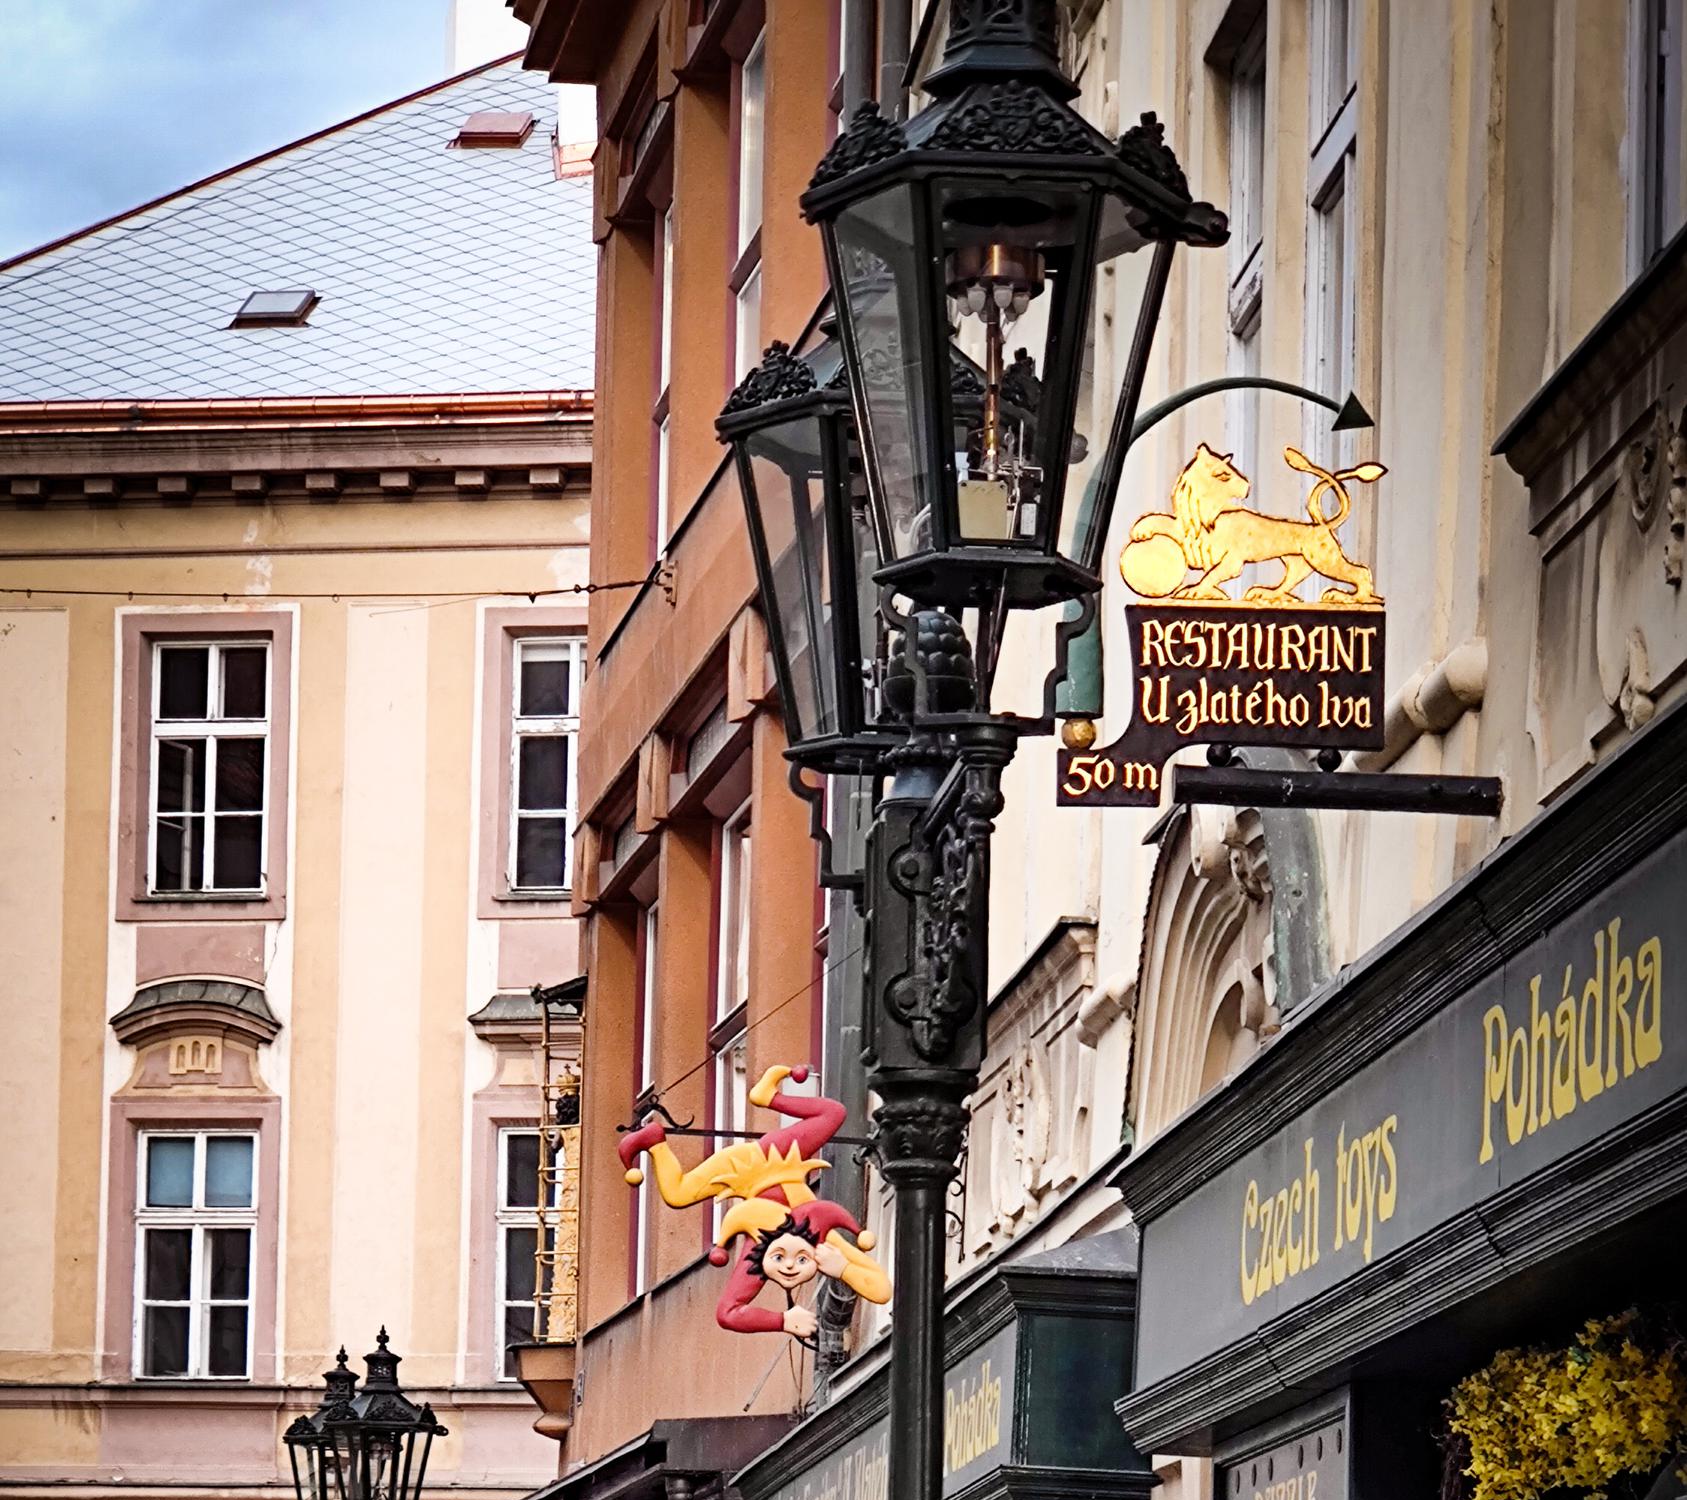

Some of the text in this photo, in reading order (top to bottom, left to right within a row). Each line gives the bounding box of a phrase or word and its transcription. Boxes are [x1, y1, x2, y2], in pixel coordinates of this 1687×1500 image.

[1139, 619, 1377, 673] RESTAURANT
[1140, 674, 1374, 735] U zlatého lva
[1062, 754, 1160, 796] 50 m
[1241, 916, 1663, 1306] Czech toys Pohádka
[943, 1358, 1002, 1479] Pohádka
